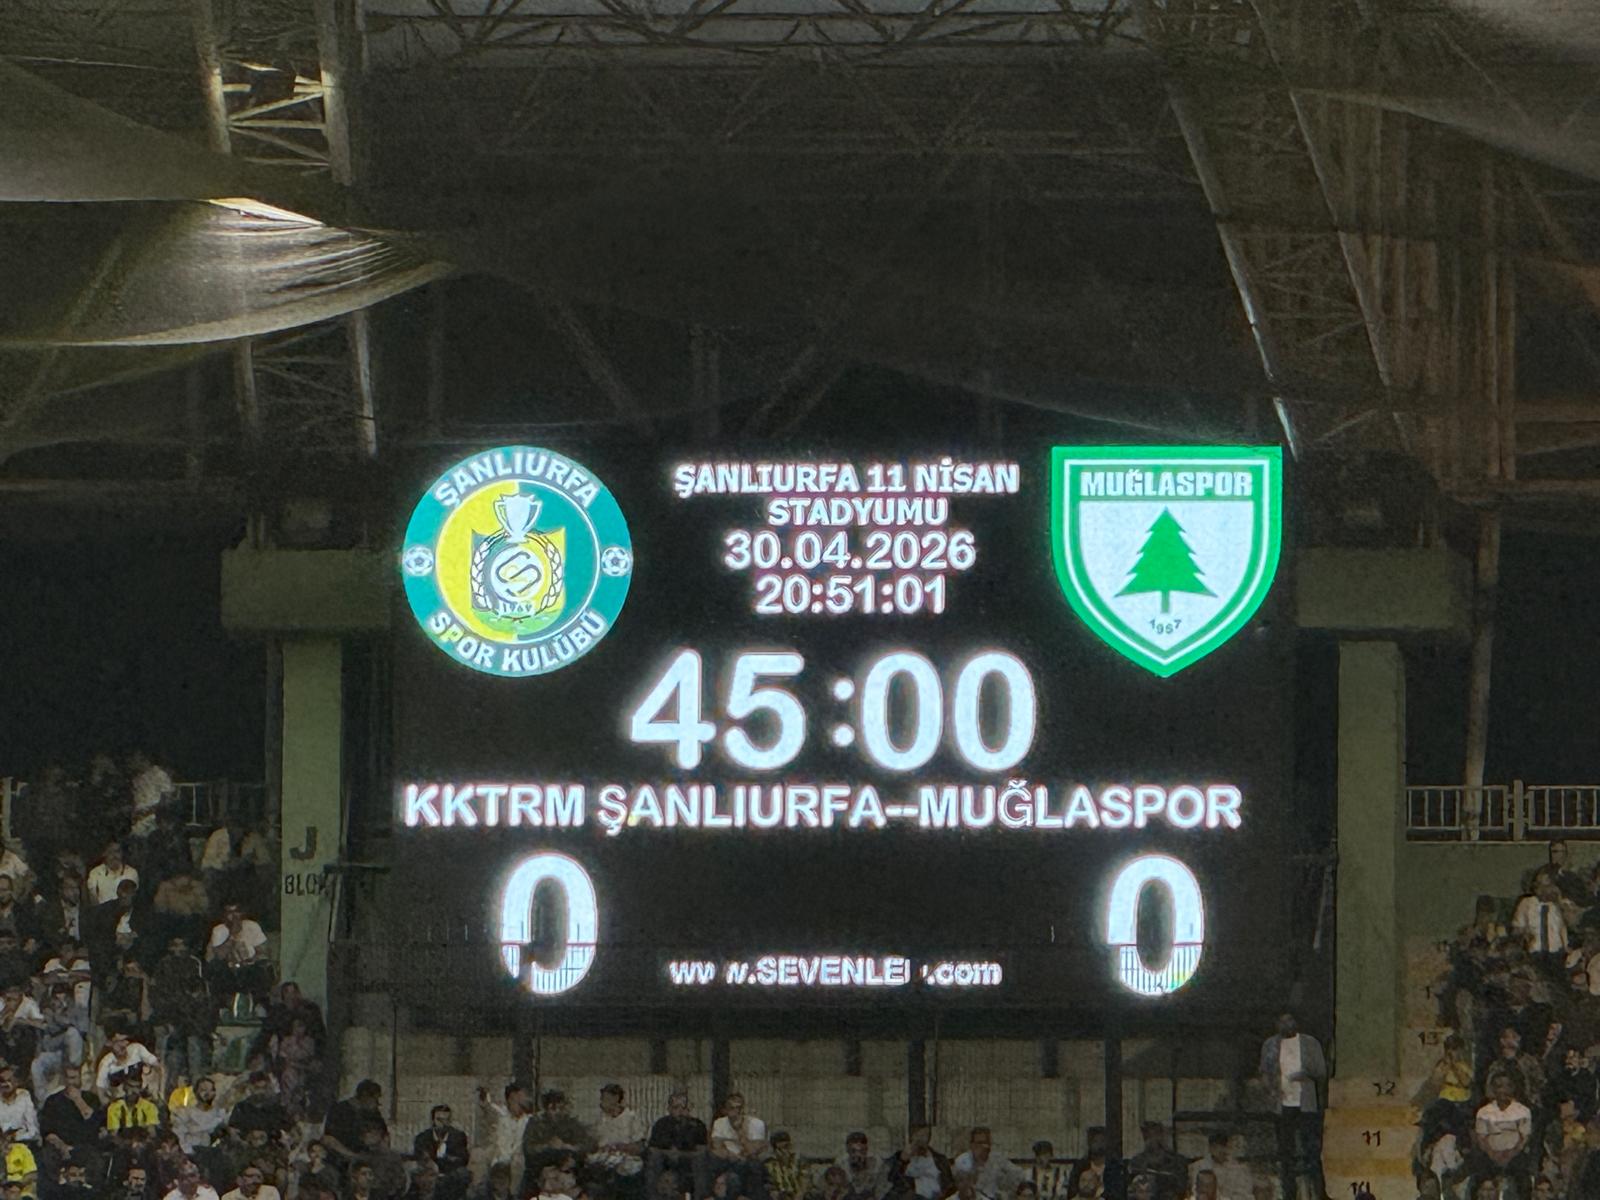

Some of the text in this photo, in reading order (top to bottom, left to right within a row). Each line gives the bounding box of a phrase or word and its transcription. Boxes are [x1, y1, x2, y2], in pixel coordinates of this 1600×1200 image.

[434, 452, 599, 508] ŞANLIURFA
[674, 457, 1020, 498] ŞANLIURFA 11 NİSAN
[1080, 468, 1253, 496] MUĞLASPOR
[767, 497, 949, 526] STADYUMU
[725, 530, 976, 570] 30.04.2026
[756, 574, 946, 614] 20:51:01
[429, 611, 495, 668] SPOR
[630, 650, 1036, 770] 45:00
[404, 784, 585, 828] KKTRM
[289, 826, 318, 860] J
[501, 853, 598, 994] 0
[1106, 854, 1204, 995] 0
[1361, 1130, 1381, 1147] 11
